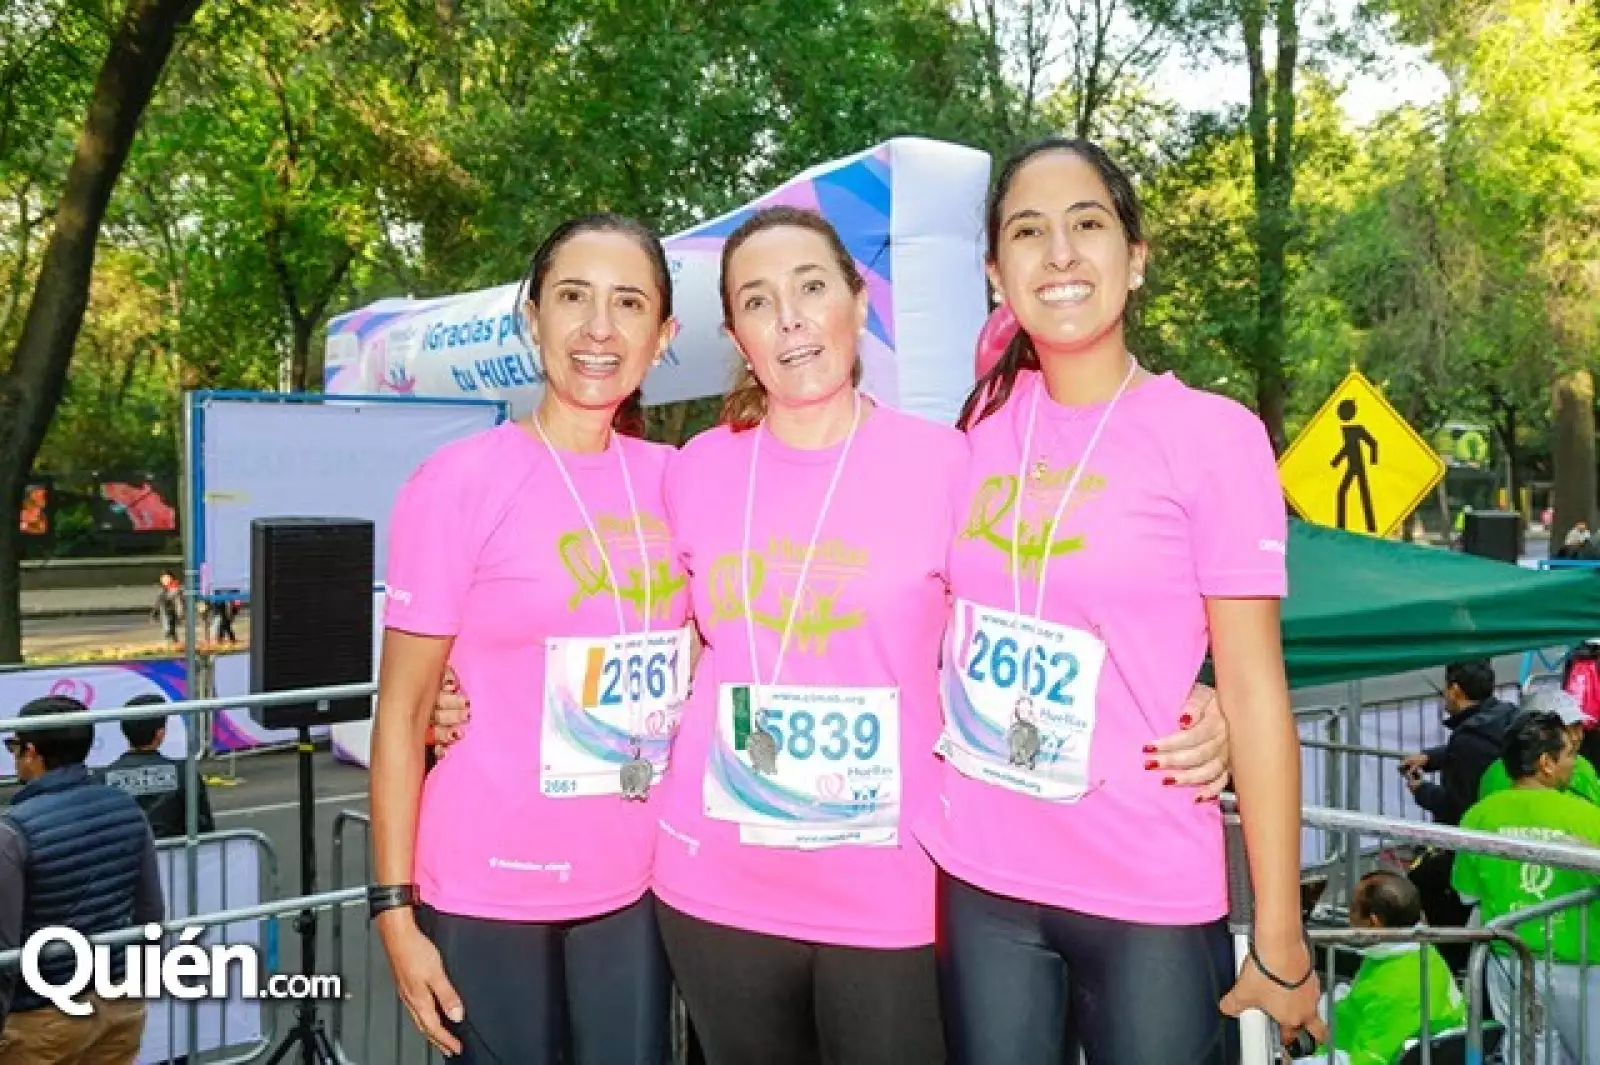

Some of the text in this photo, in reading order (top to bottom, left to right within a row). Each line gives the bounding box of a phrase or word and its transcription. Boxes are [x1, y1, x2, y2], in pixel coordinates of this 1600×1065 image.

[475, 352, 541, 389] HUELL
[599, 649, 679, 706] 2661
[966, 630, 1081, 705] 2662
[757, 709, 881, 761] 5839
[544, 779, 578, 793] 2661
